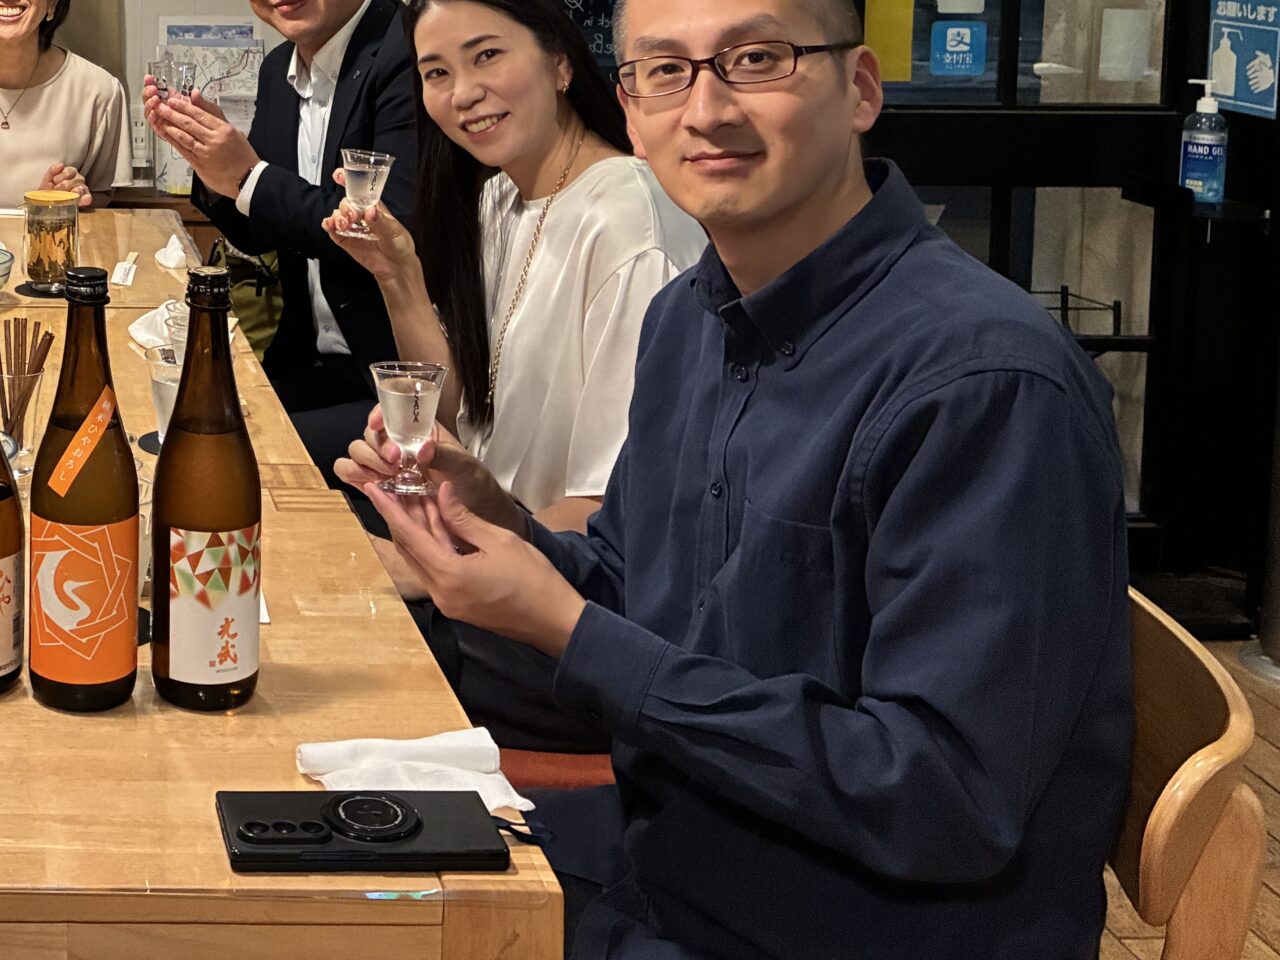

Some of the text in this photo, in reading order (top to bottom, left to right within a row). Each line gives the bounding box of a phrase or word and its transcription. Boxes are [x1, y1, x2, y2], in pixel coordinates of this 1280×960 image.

[1216, 0, 1278, 22] お願いします
[1187, 144, 1224, 156] HAND GEL
[216, 617, 239, 665] 光武
